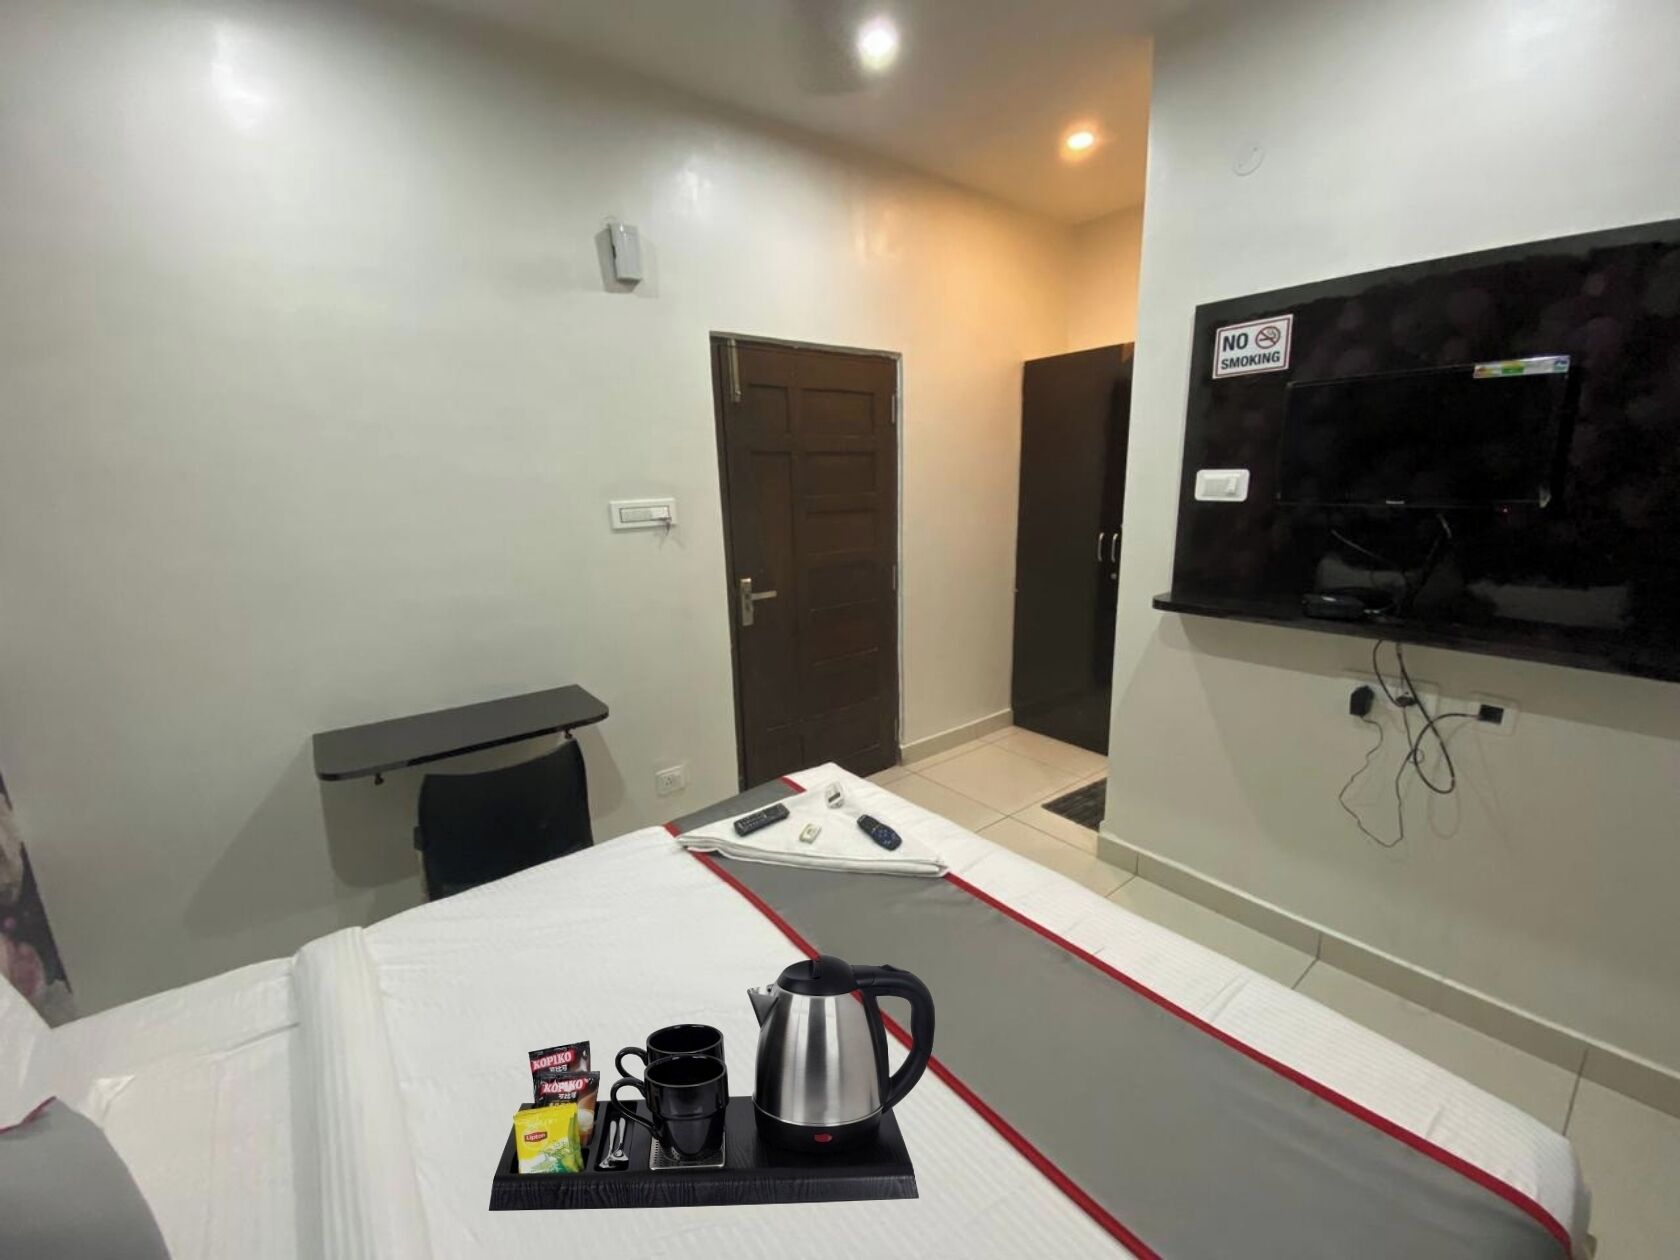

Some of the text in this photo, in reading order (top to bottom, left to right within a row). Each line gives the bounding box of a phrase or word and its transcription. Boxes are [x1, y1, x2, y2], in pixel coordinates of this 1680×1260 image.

[1223, 332, 1249, 352] NO
[1221, 351, 1280, 370] SMOKING
[532, 1051, 572, 1071] KOPIKO
[526, 1132, 546, 1141] Lipton
